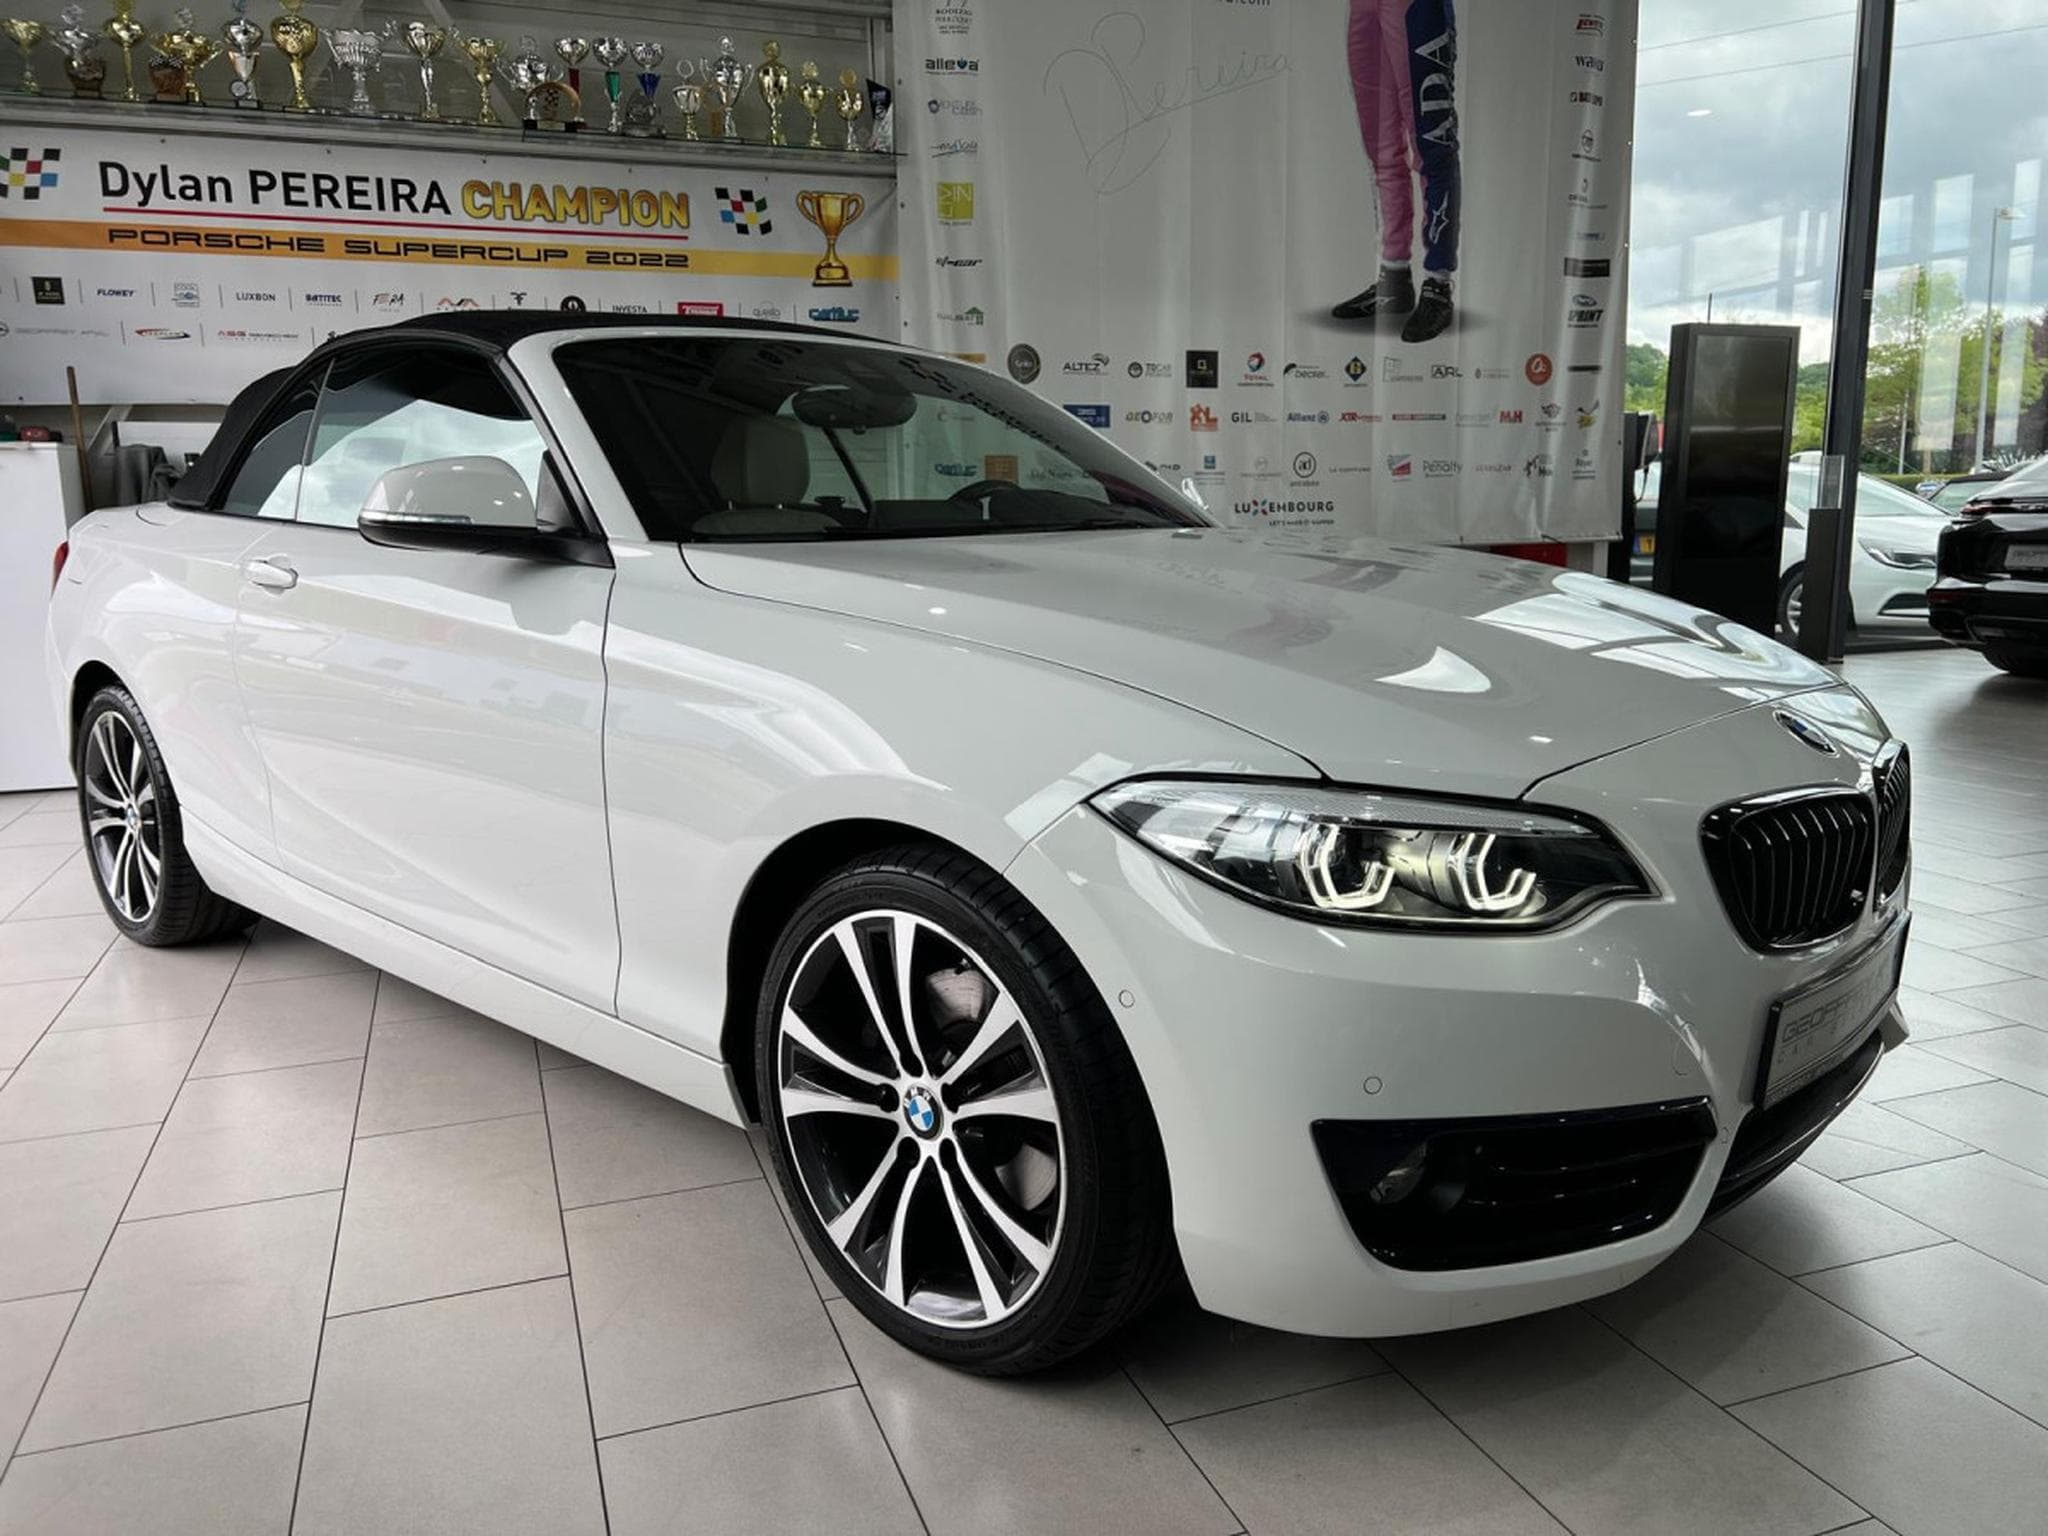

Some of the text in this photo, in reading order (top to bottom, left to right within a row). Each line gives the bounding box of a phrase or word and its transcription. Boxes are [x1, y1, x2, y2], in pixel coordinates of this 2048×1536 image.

[99, 161, 690, 230] Dylan PEREIRA CHAMPION
[108, 228, 690, 269] PORSCHE SUPERCUP 2022
[236, 292, 276, 302] LUXBON
[612, 304, 648, 314] INVESTA
[1231, 411, 1252, 423] GIL
[1286, 412, 1316, 422] Allianz
[1234, 499, 1335, 517] LUXEMBOURG
